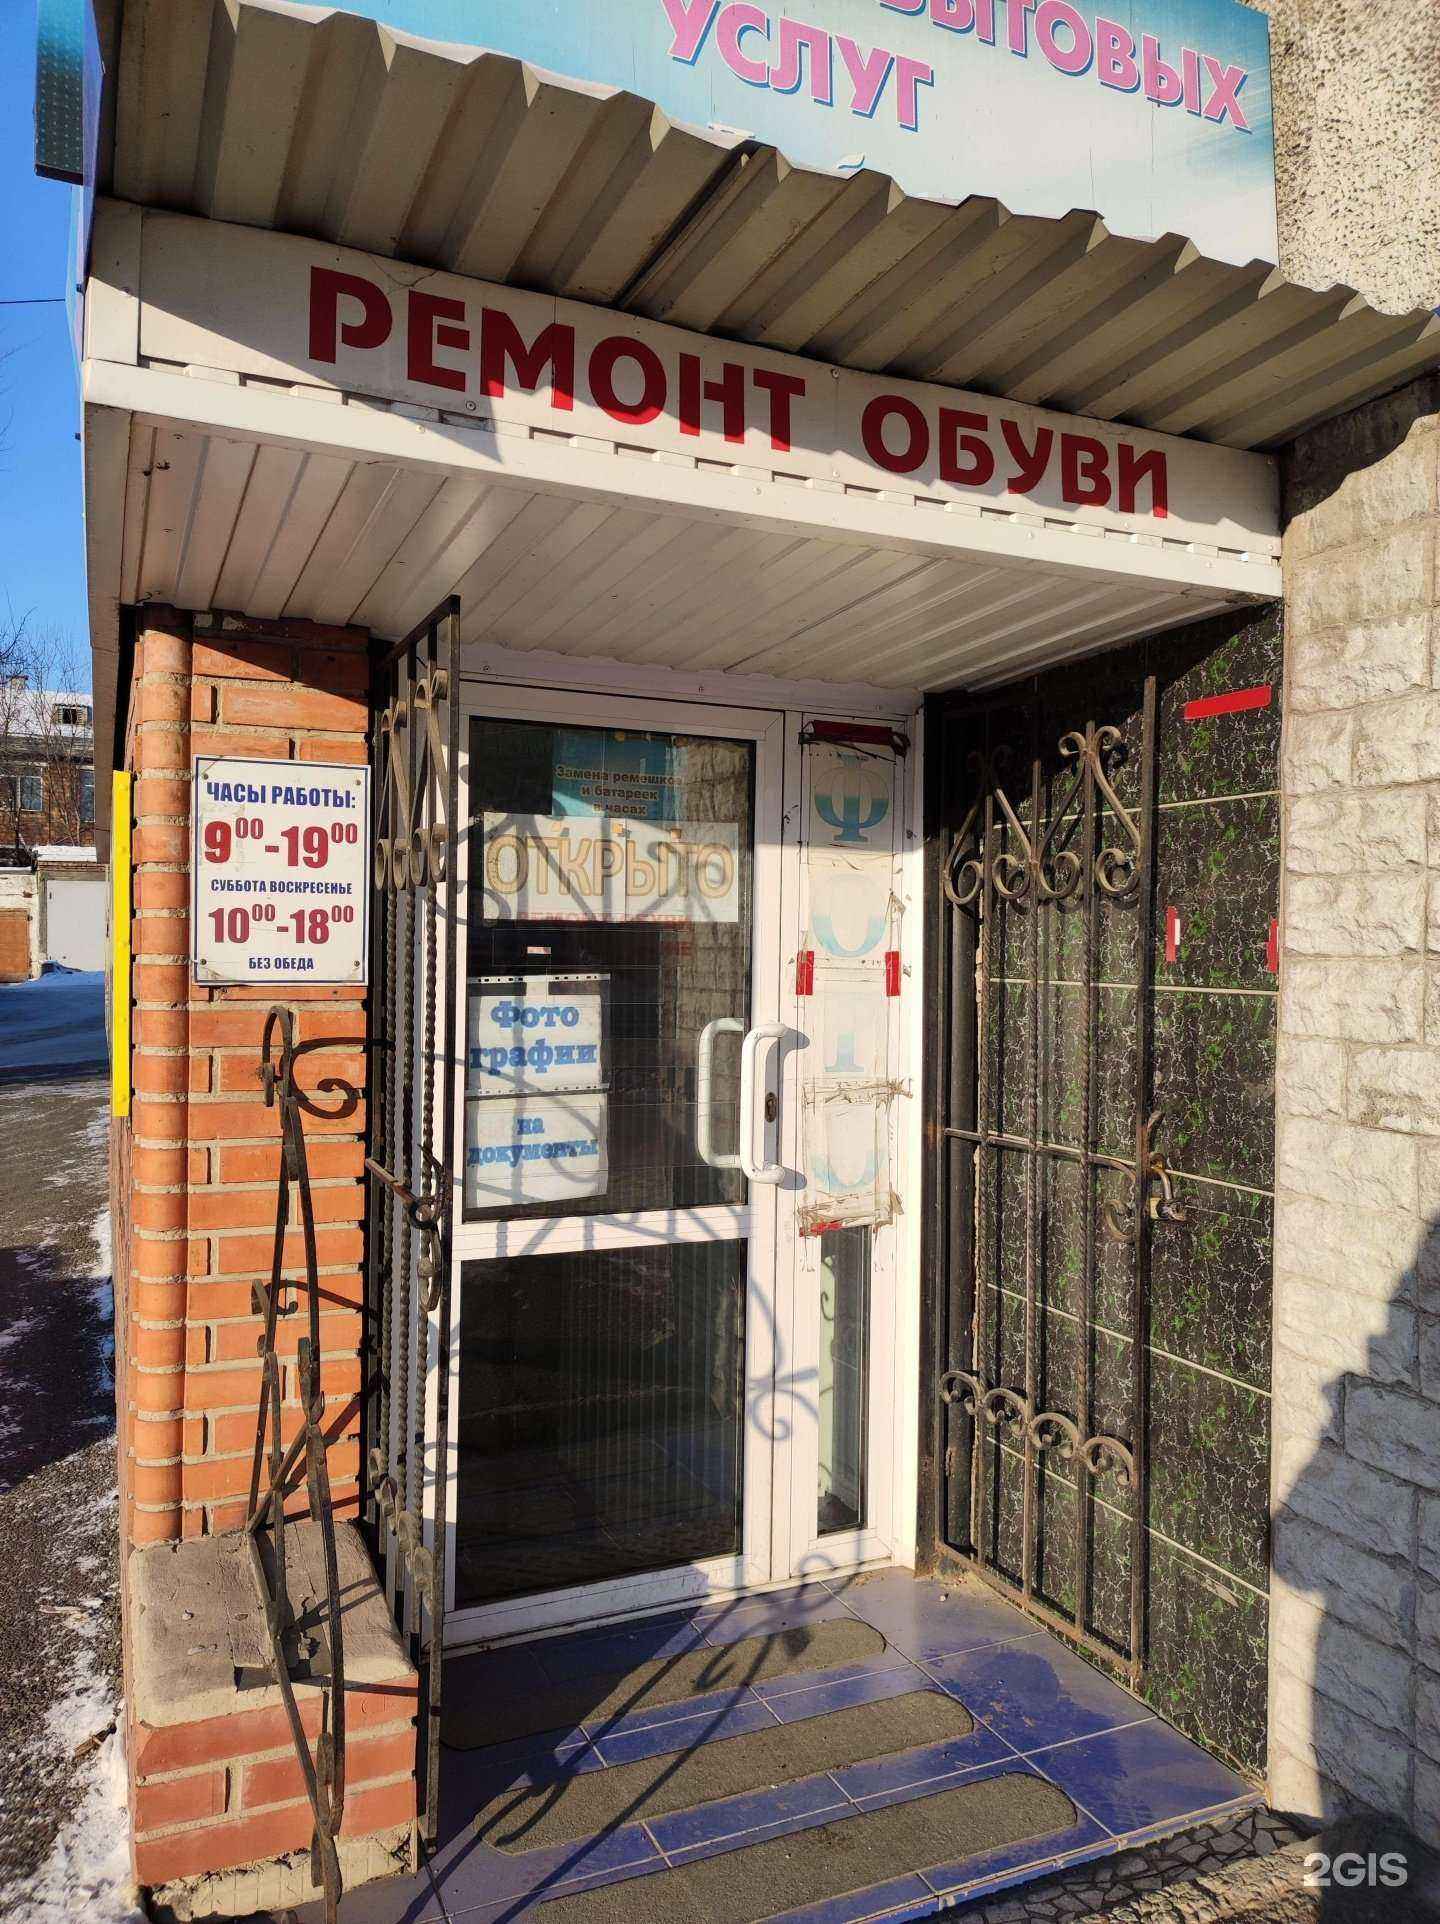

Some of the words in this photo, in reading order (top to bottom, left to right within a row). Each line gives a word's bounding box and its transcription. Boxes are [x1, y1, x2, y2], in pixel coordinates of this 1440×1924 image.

[660, 0, 934, 132] УСЛУГ
[308, 265, 806, 452] РЕМОНТ
[861, 393, 1168, 518] ОБУВИ
[206, 781, 266, 804] ЧАСЫ
[272, 785, 356, 809] РАБОТЫ:
[605, 804, 647, 815] часах
[486, 833, 735, 899] ОТКРЫТО
[210, 879, 267, 893] СУББОТА
[270, 880, 352, 895] ВОСКРЕСЕНЬЕ
[248, 957, 271, 970] БЕЗ
[274, 957, 314, 970] ОБЕДА
[470, 1038, 597, 1074] графии
[517, 1117, 545, 1135] на
[467, 1139, 599, 1168] документы
